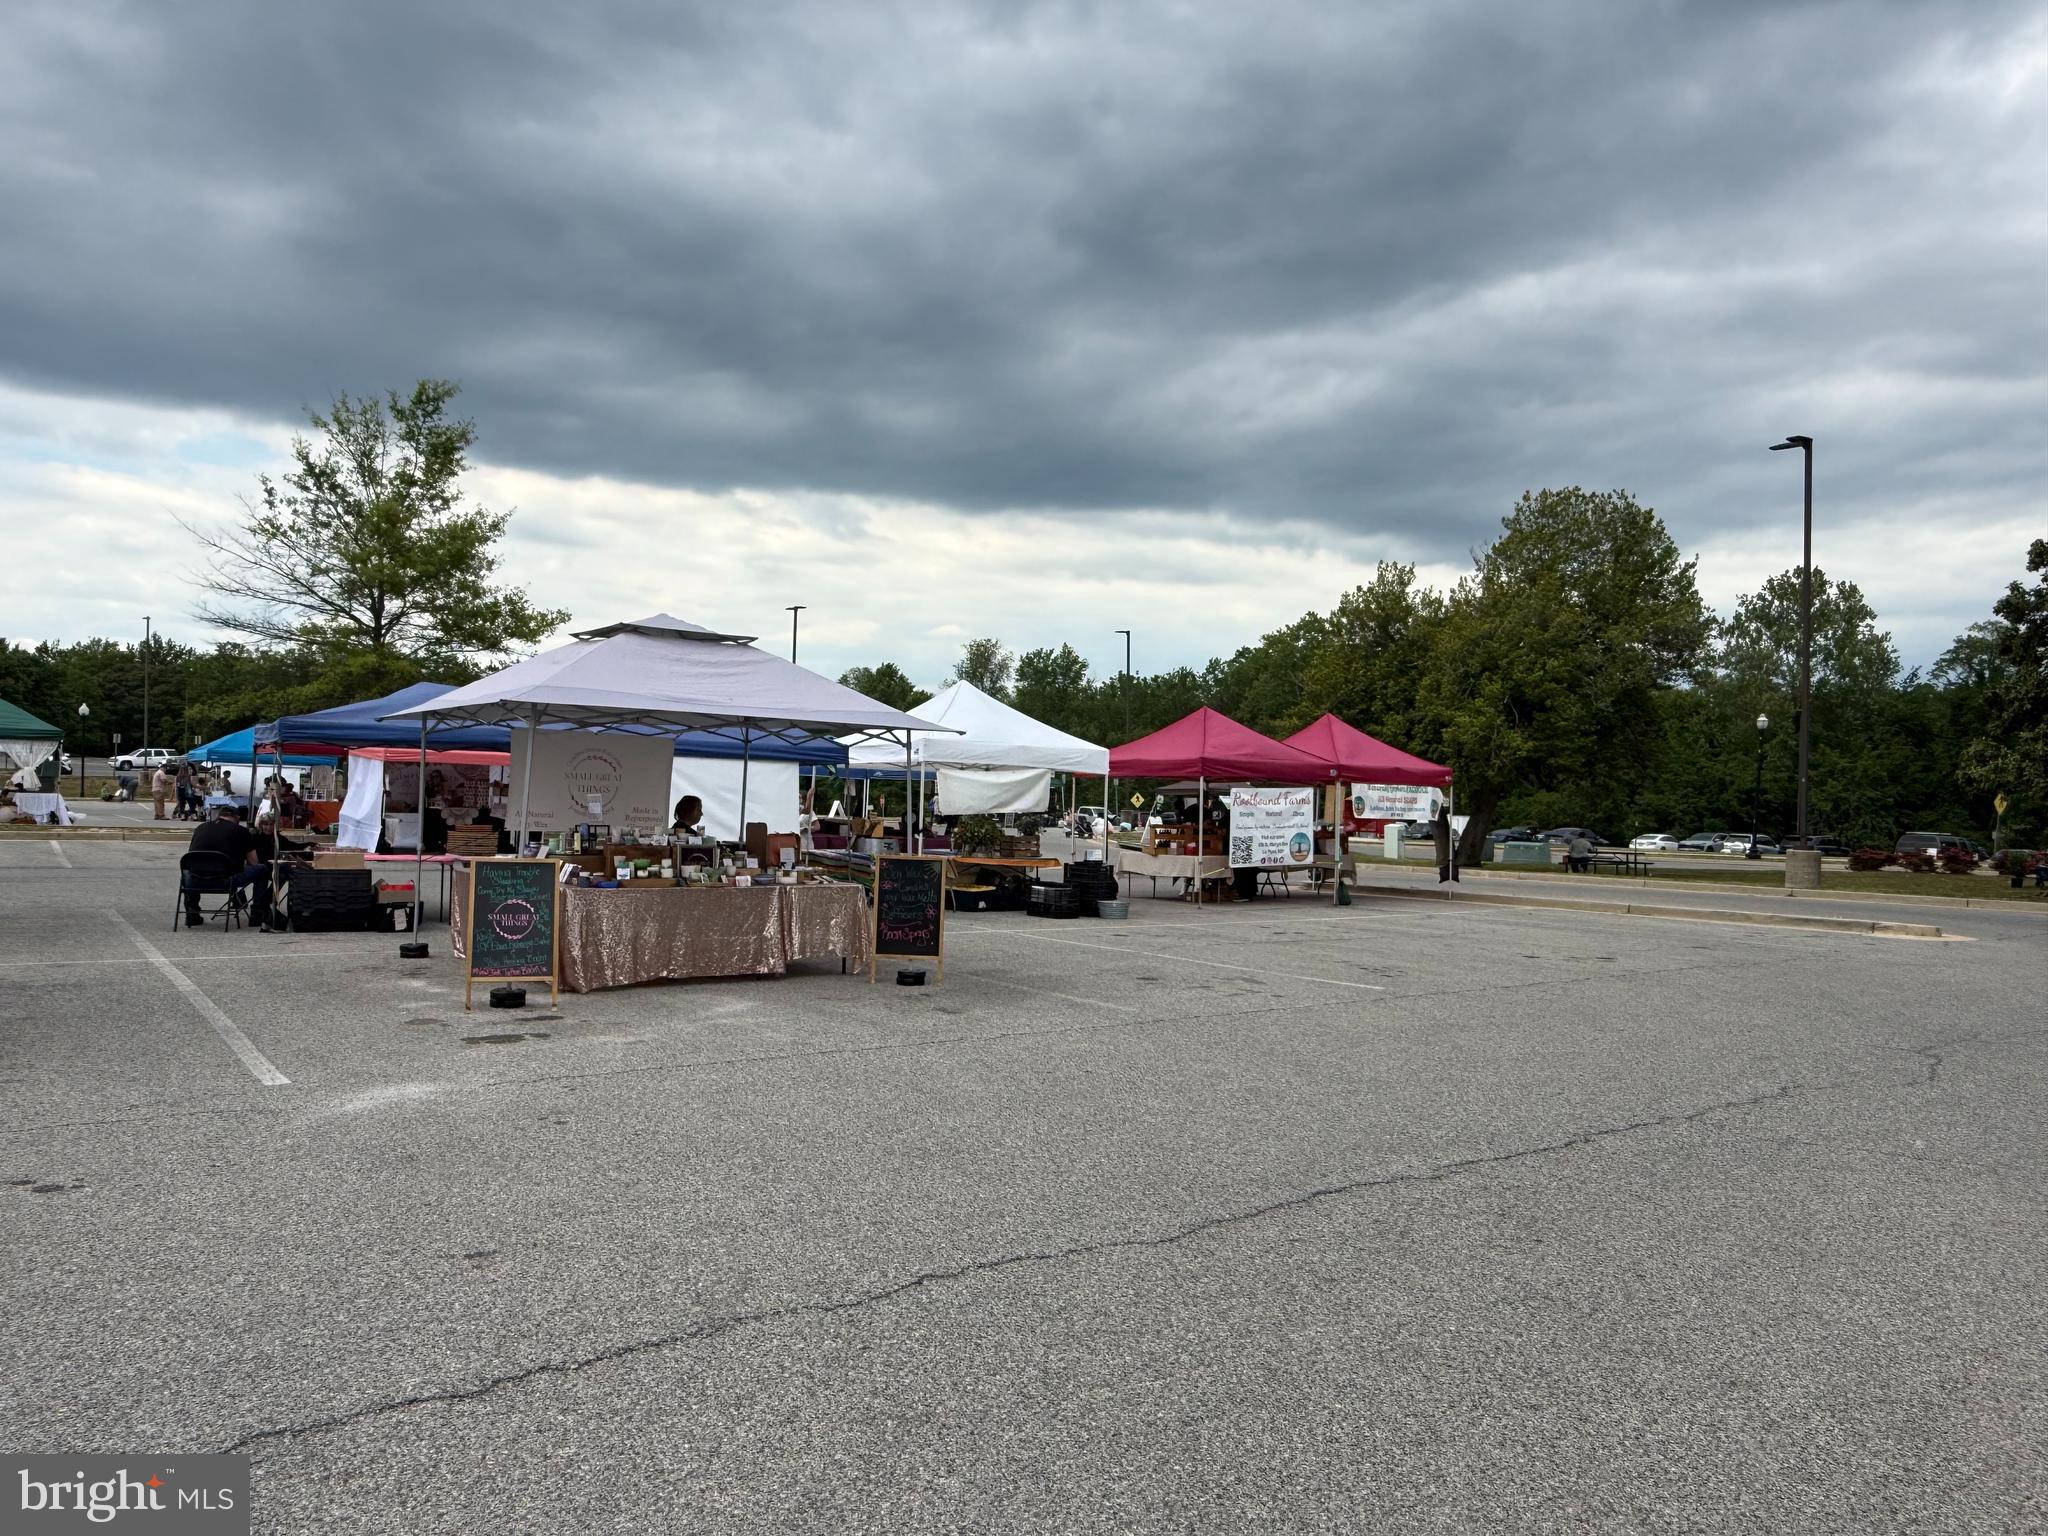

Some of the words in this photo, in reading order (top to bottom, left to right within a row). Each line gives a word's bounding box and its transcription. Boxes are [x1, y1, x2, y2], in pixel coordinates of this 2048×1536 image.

[564, 772, 592, 781] SMALL
[576, 784, 611, 794] THINGS
[1283, 791, 1311, 806] Farms
[528, 810, 554, 818] Natural
[632, 807, 650, 815] Made
[625, 815, 664, 824] Repurposed
[487, 913, 513, 921] SMALL
[515, 913, 540, 921] GREAT
